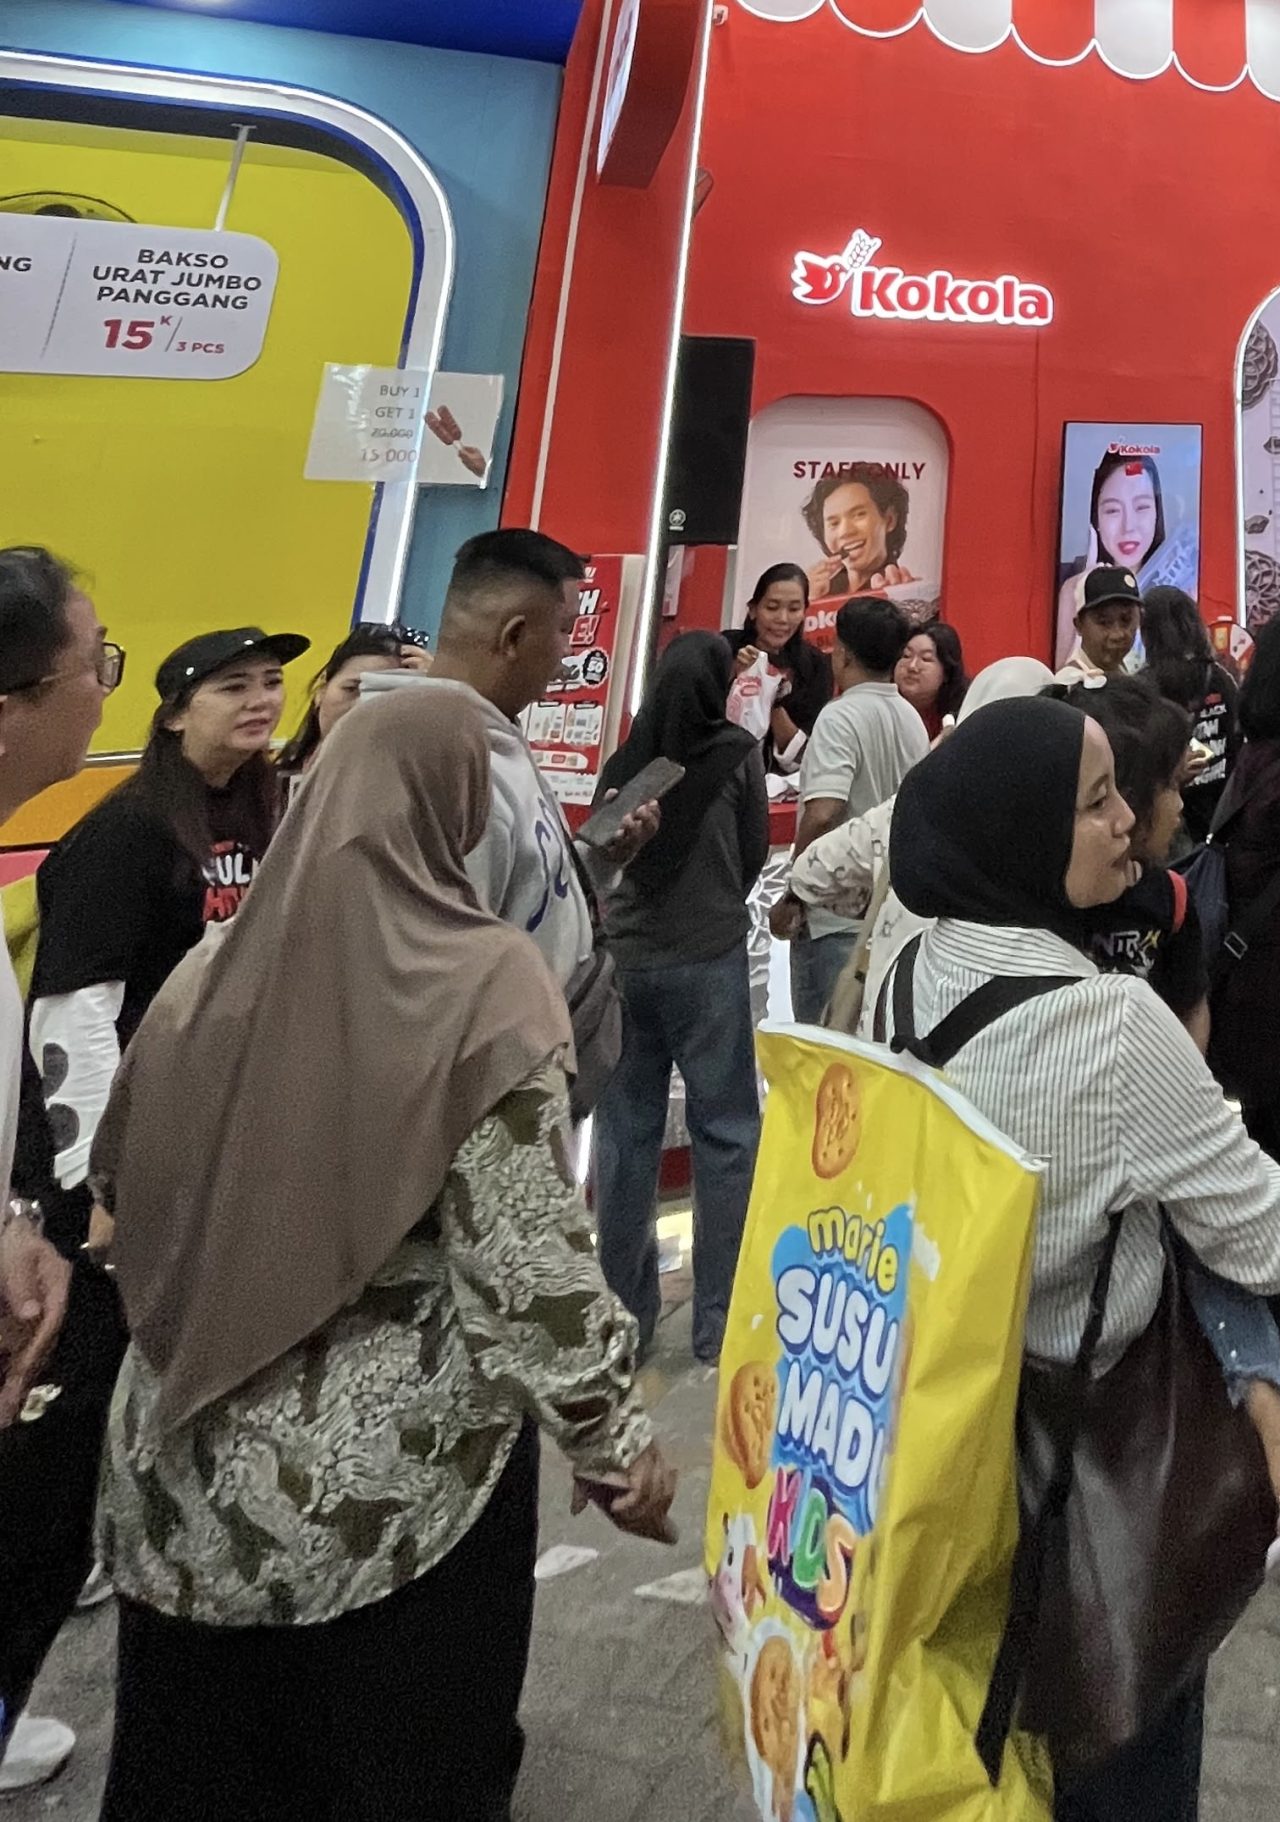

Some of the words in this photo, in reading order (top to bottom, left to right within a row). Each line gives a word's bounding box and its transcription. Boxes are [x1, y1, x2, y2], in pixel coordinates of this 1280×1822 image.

[137, 249, 229, 269] BAKSO
[93, 266, 164, 285] URAT
[170, 273, 262, 291] JUMBO
[97, 286, 249, 310] PANGGANG
[855, 267, 1051, 323] Kokola
[191, 342, 225, 354] PCS
[380, 384, 409, 397] BUY
[375, 406, 404, 418] GET
[809, 1206, 898, 1293] marie
[776, 1268, 897, 1396] SUSU
